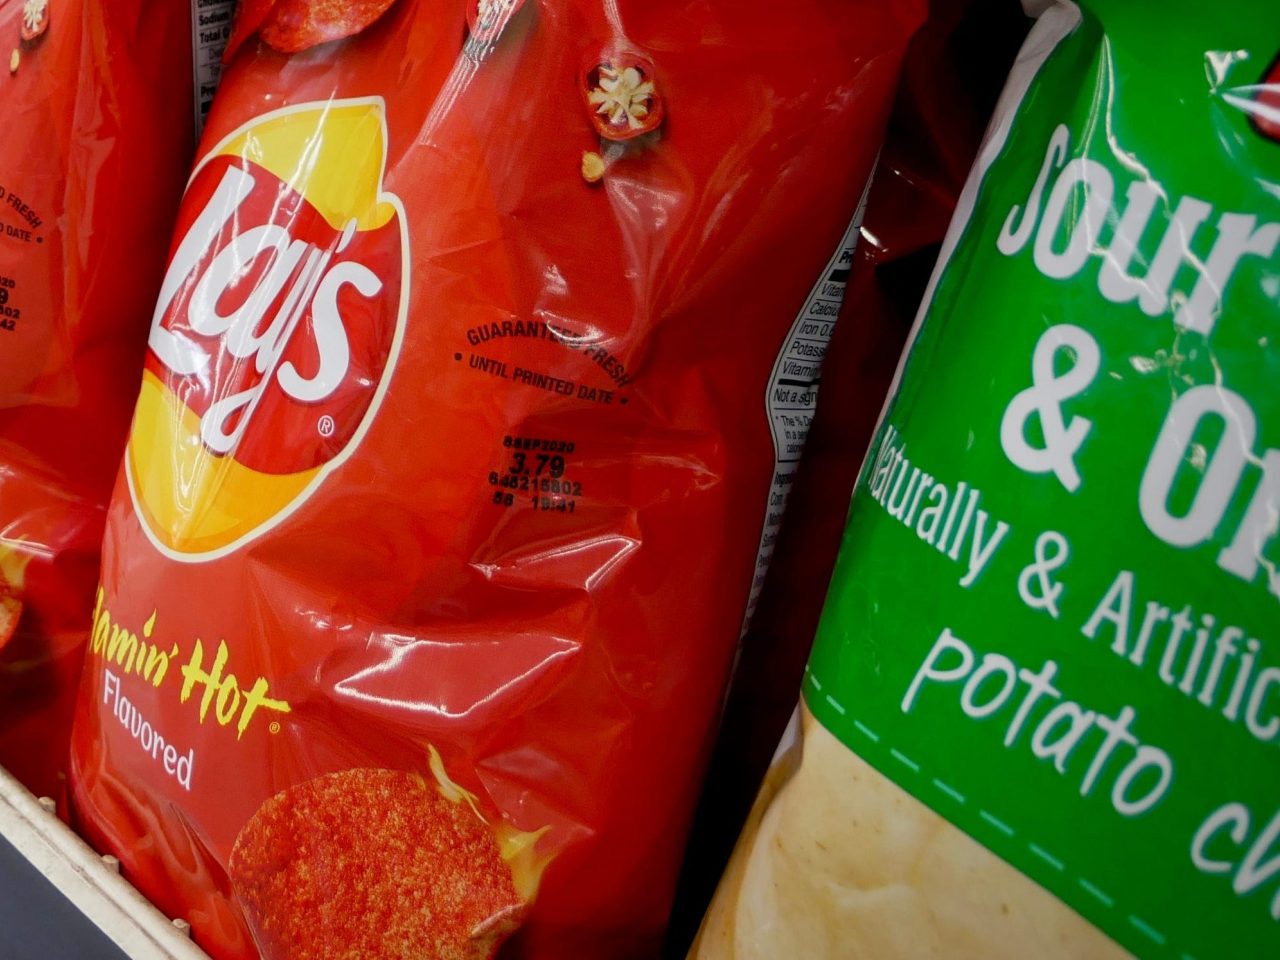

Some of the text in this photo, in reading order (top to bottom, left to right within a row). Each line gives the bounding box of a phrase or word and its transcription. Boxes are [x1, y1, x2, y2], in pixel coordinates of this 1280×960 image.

[6, 193, 42, 230] FRESH
[6, 224, 32, 243] DATE
[996, 123, 1280, 336] Sour
[148, 164, 384, 453] Lay's
[799, 321, 819, 337] Iron
[469, 354, 615, 405] UNTIL PRINTED DATE
[774, 387, 789, 403] Not
[1000, 324, 1100, 492] &
[509, 452, 565, 478] 3.79
[867, 424, 1009, 588] Naturally
[1018, 530, 1071, 619] &
[103, 668, 194, 792] Flavored
[181, 637, 291, 741] Hot
[901, 627, 1173, 816] potato
